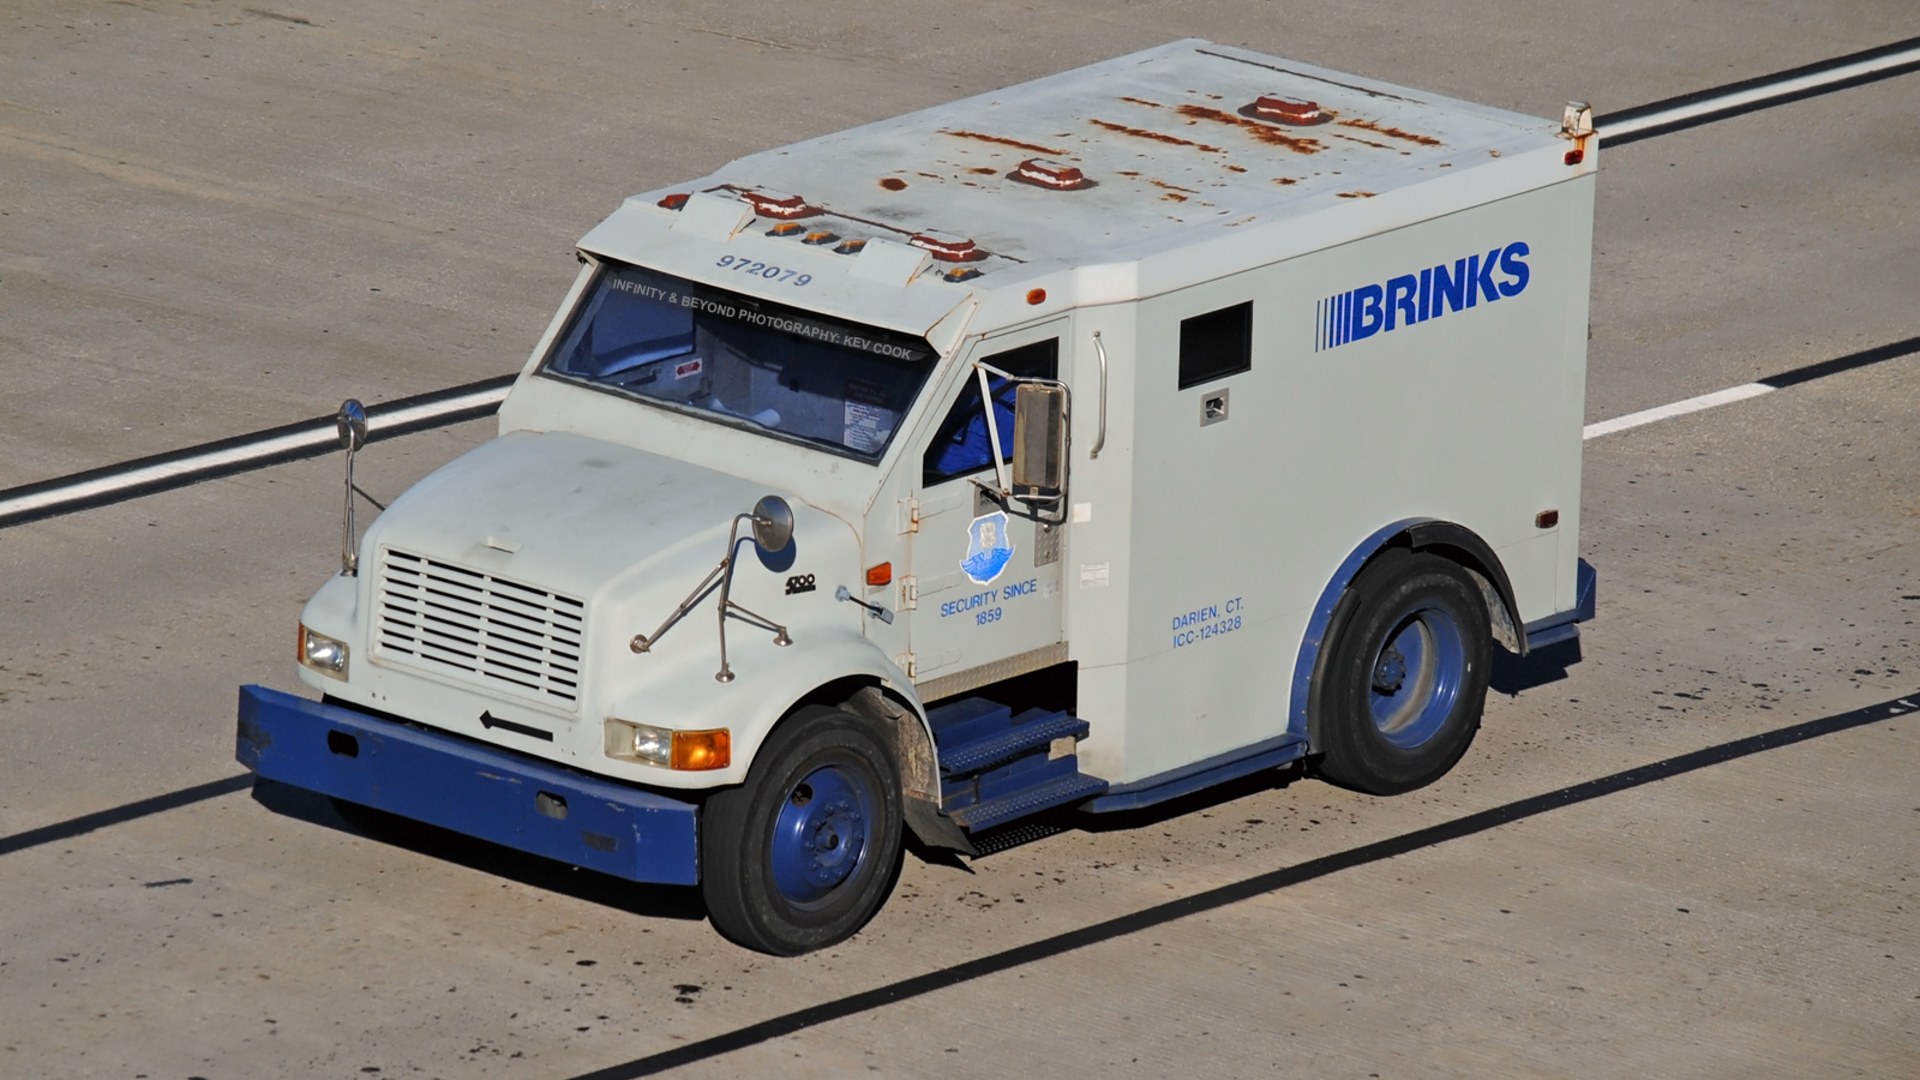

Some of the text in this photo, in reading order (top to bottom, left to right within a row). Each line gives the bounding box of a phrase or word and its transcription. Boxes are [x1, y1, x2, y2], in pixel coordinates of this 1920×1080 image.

[716, 254, 812, 287] 972079
[1351, 241, 1531, 342] BRINKS
[940, 589, 998, 617] SECURITY
[1003, 578, 1037, 600] SINCE
[1225, 596, 1244, 614] CT.
[975, 606, 1002, 626] 1859
[1172, 615, 1242, 649] ICC-124328
